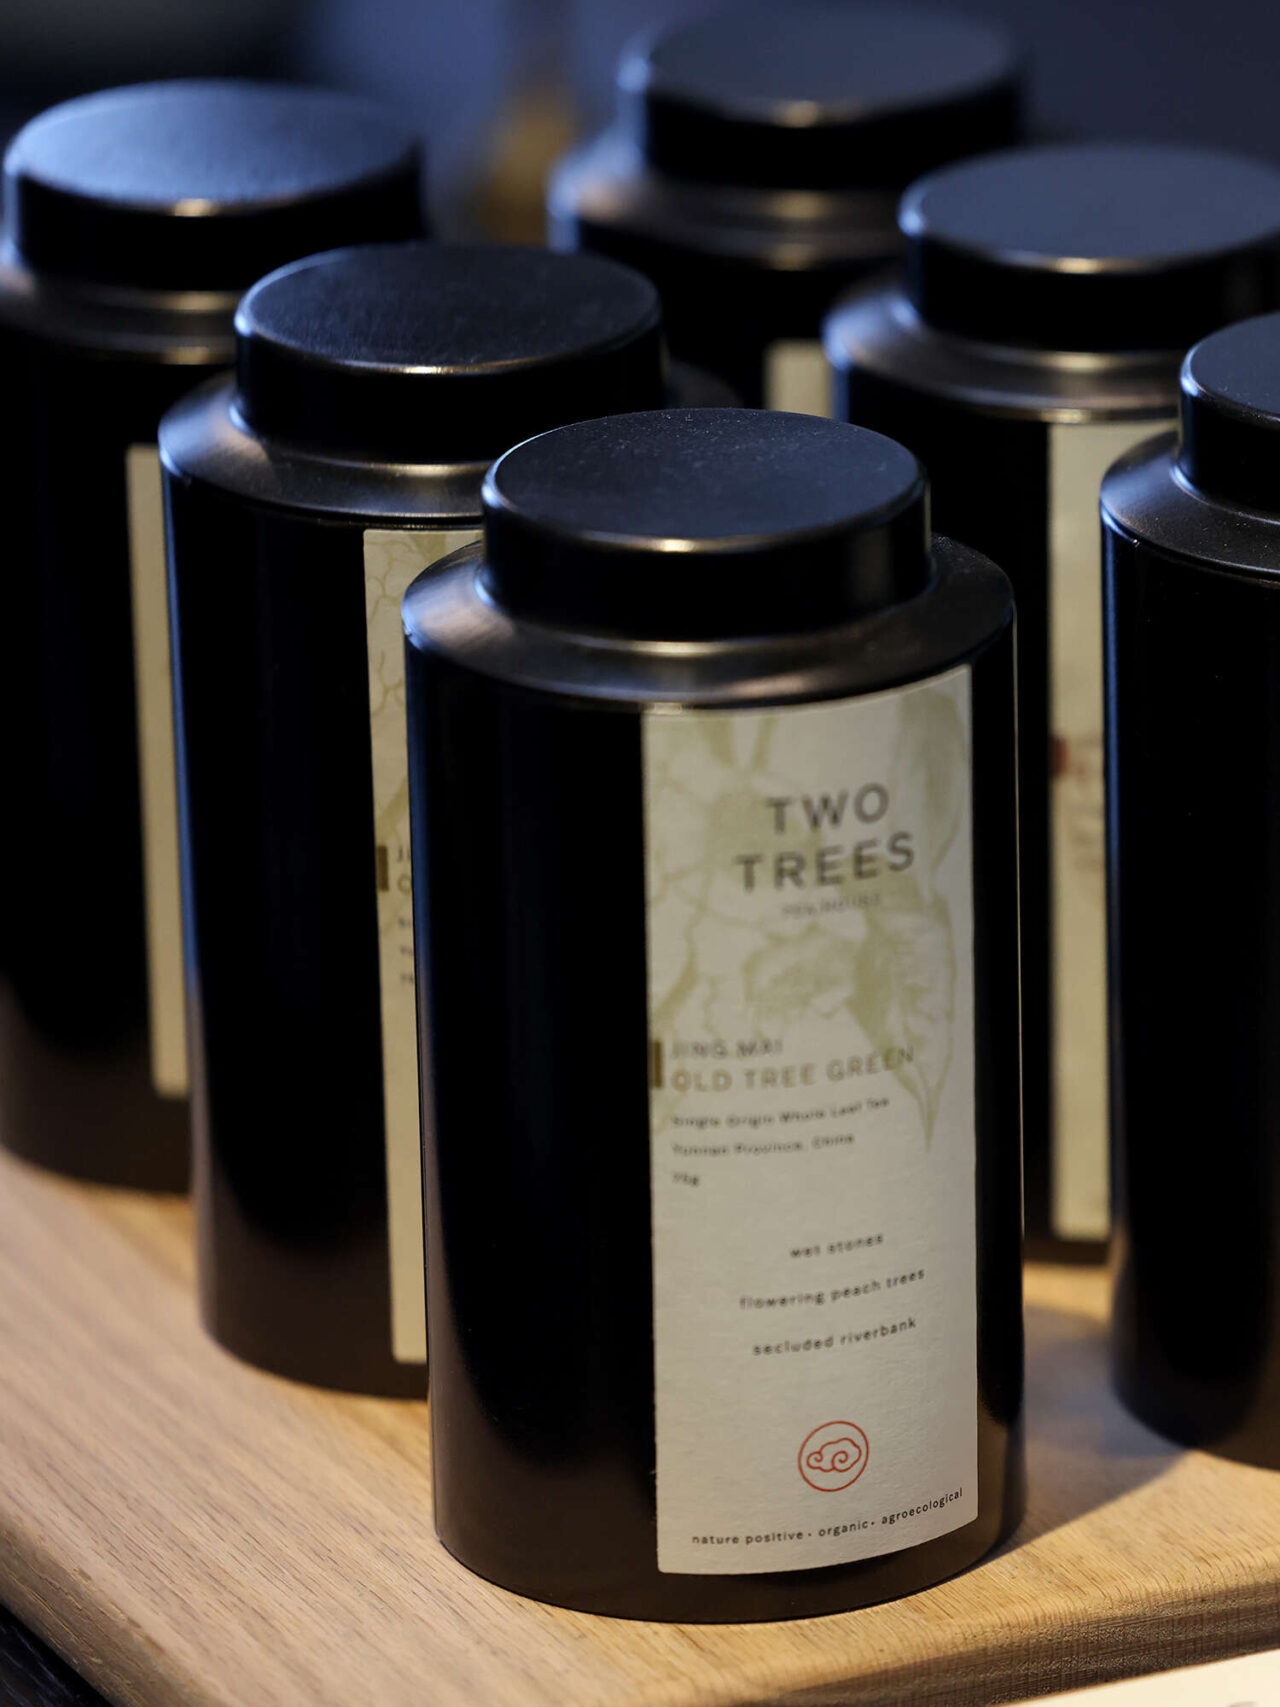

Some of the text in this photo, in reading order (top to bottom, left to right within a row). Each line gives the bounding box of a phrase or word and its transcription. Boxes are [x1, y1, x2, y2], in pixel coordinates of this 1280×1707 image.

[766, 782, 890, 834] TWO
[734, 830, 915, 892] TREES
[670, 1045, 915, 1092] OLD TREE GREEN
[790, 1233, 884, 1259] wet stones
[739, 1268, 926, 1310] flowering peach trees
[753, 1317, 918, 1356] secluded riverbank
[692, 1487, 964, 1546] nature positive organic agroecological
